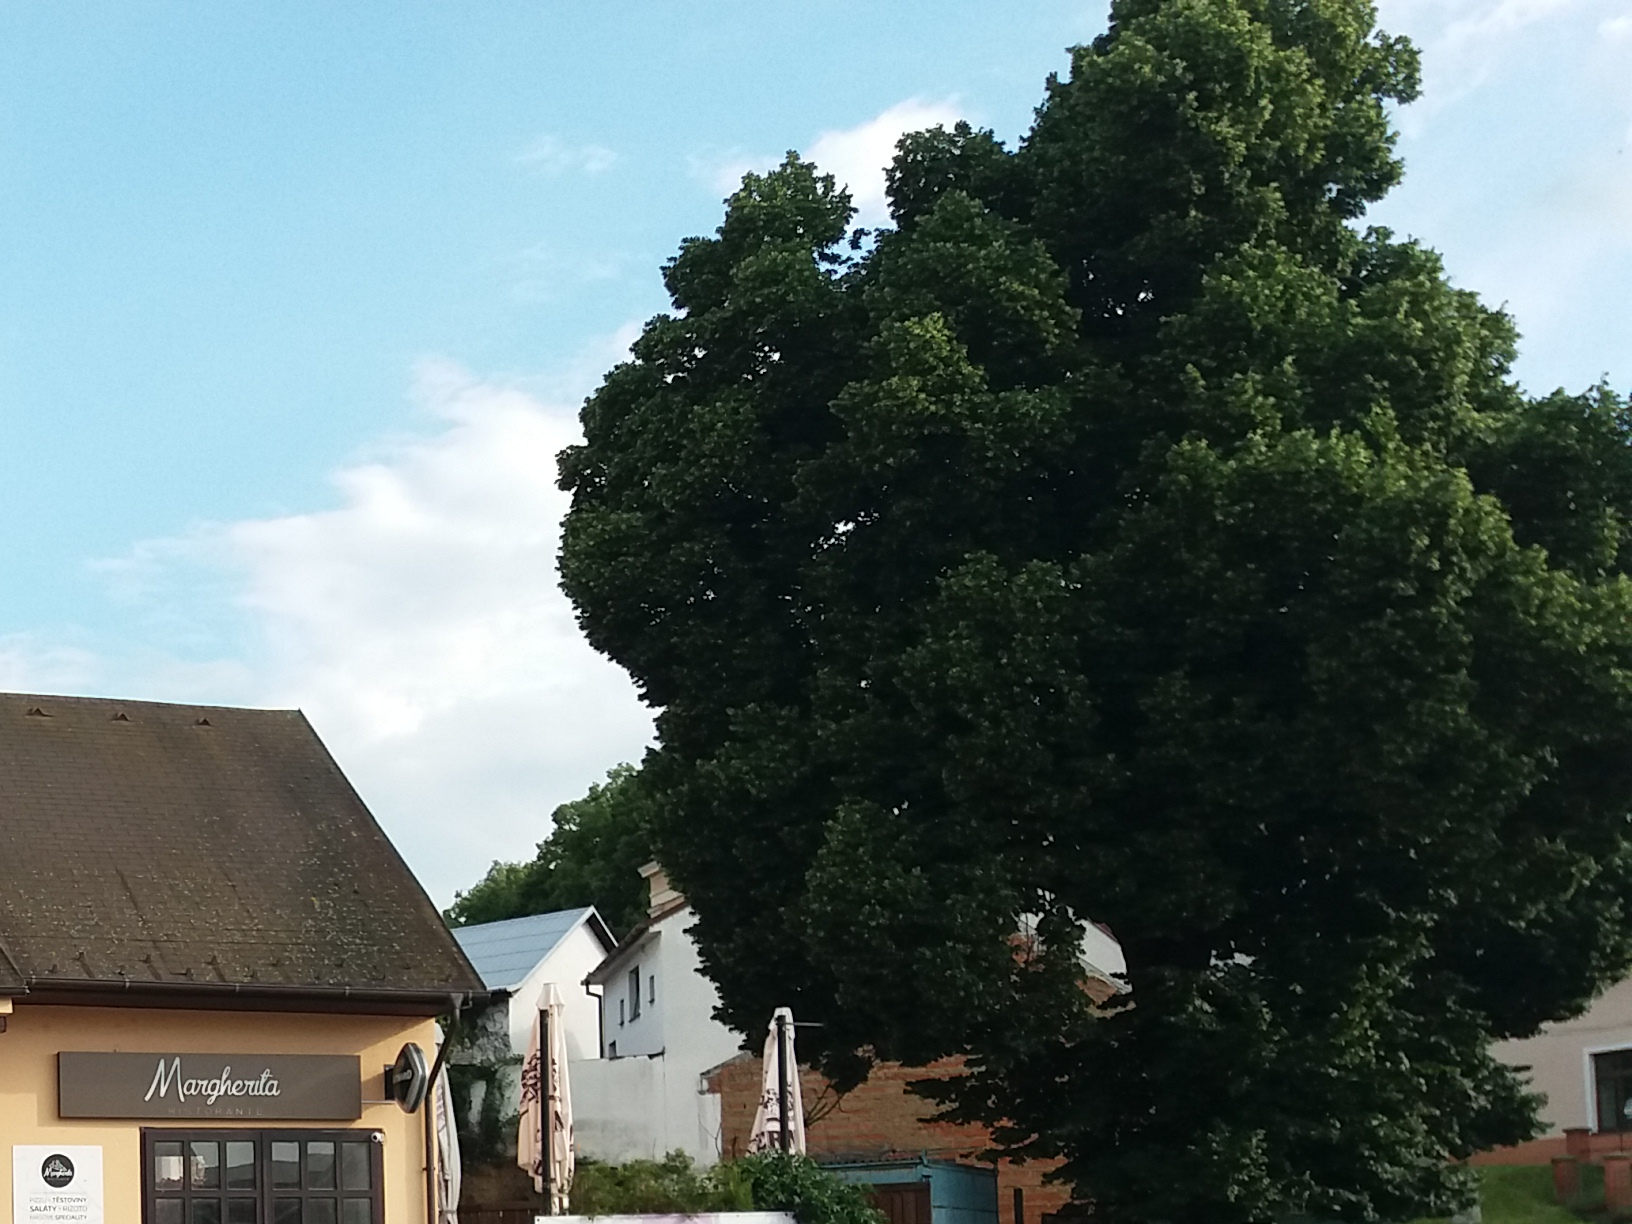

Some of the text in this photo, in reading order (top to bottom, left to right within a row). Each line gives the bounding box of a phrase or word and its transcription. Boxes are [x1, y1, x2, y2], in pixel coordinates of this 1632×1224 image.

[144, 1056, 281, 1106] Margherita
[168, 1107, 264, 1117] RISTORANTE
[29, 1204, 57, 1213] SALÁTY
